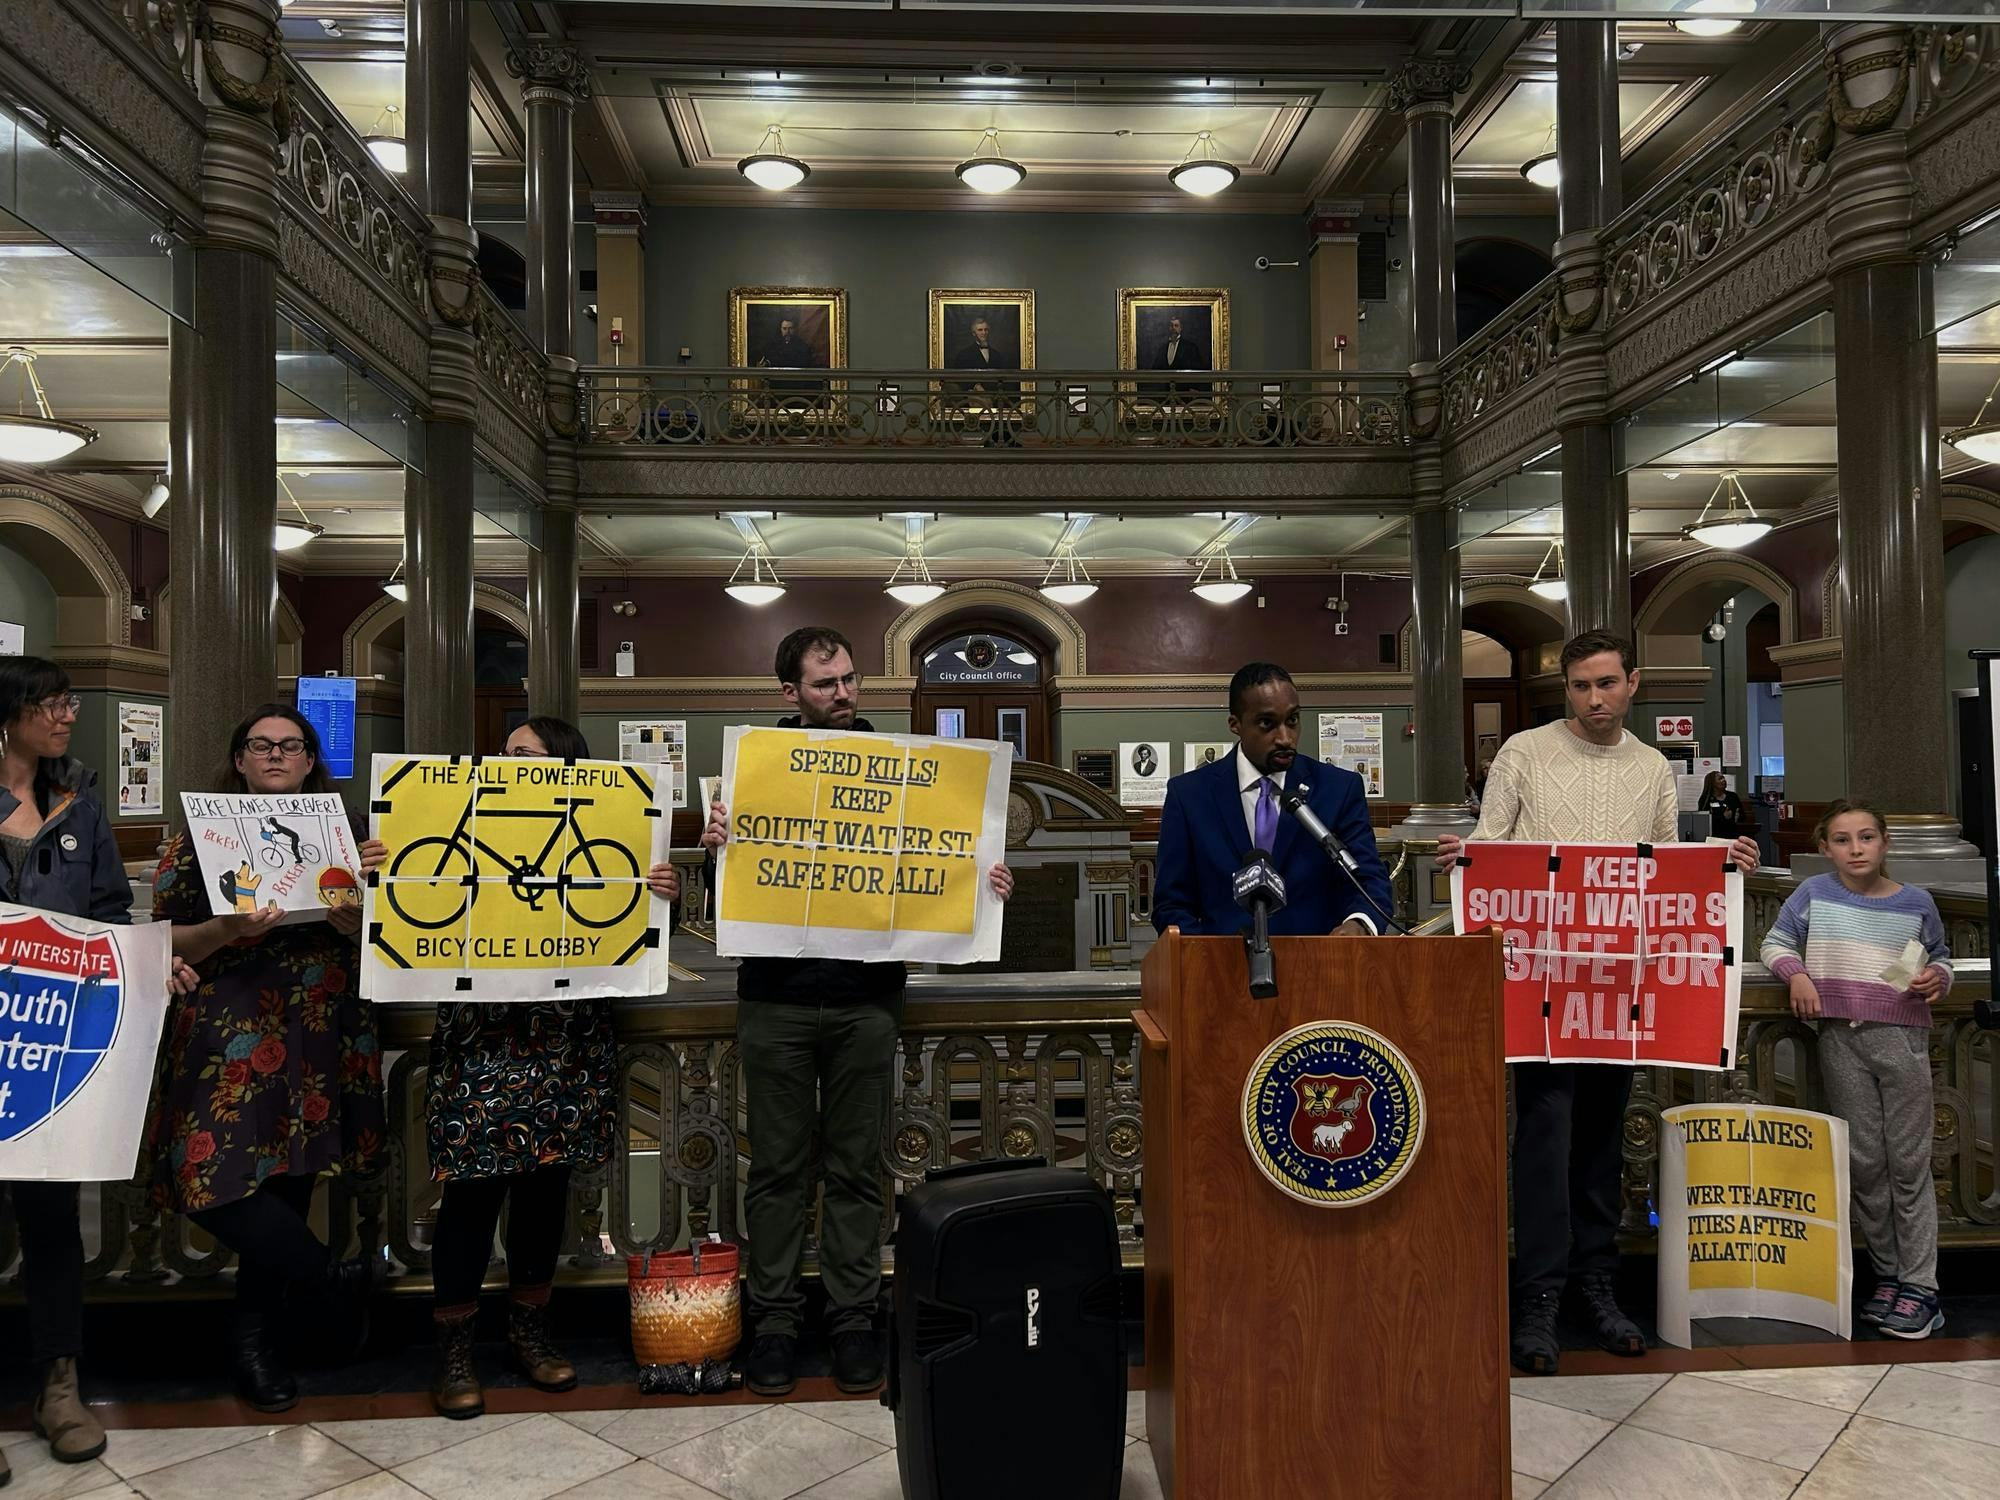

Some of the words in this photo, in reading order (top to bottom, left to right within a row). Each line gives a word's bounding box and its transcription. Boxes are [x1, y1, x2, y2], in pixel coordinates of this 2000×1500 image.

[939, 672, 957, 681] City
[960, 672, 993, 680] Council
[996, 671, 1022, 680] Office
[1660, 724, 1674, 732] STOP
[420, 766, 459, 784] THE
[466, 767, 508, 784] ALL
[516, 767, 624, 788] POWERFUL
[790, 748, 861, 777] SPEED
[865, 755, 939, 784] KILLS!
[186, 796, 228, 817] BIKE
[226, 797, 273, 815] LANES
[277, 798, 339, 815] FUREVER!
[830, 786, 893, 813] KEEP
[204, 828, 239, 853] BIKES!
[736, 814, 828, 850] SOUTH
[833, 821, 934, 856] WATER
[937, 829, 975, 859] ST.
[757, 858, 826, 891] SAFE
[830, 864, 884, 895] FOR
[889, 867, 946, 896] ALL!
[1583, 856, 1657, 889] KEEP
[1468, 888, 1576, 925] SOUTH
[1585, 891, 1697, 928] WATER
[11, 940, 112, 972] INTERSTATE
[416, 937, 517, 958] BICYCLE
[525, 936, 603, 958] LOBBY
[1503, 928, 1618, 985] SAFE
[1630, 932, 1720, 987] FOR
[1560, 991, 1656, 1041] ALL!
[1278, 1040, 1351, 1075] COUNCIL,
[1261, 1076, 1280, 1116] CITY
[1262, 1121, 1279, 1146] OF
[1726, 1119, 1814, 1150] LANES:
[1277, 1147, 1311, 1181] SEAL
[1728, 1185, 1816, 1214] TRAFFIC
[1738, 1215, 1808, 1241] AFTER
